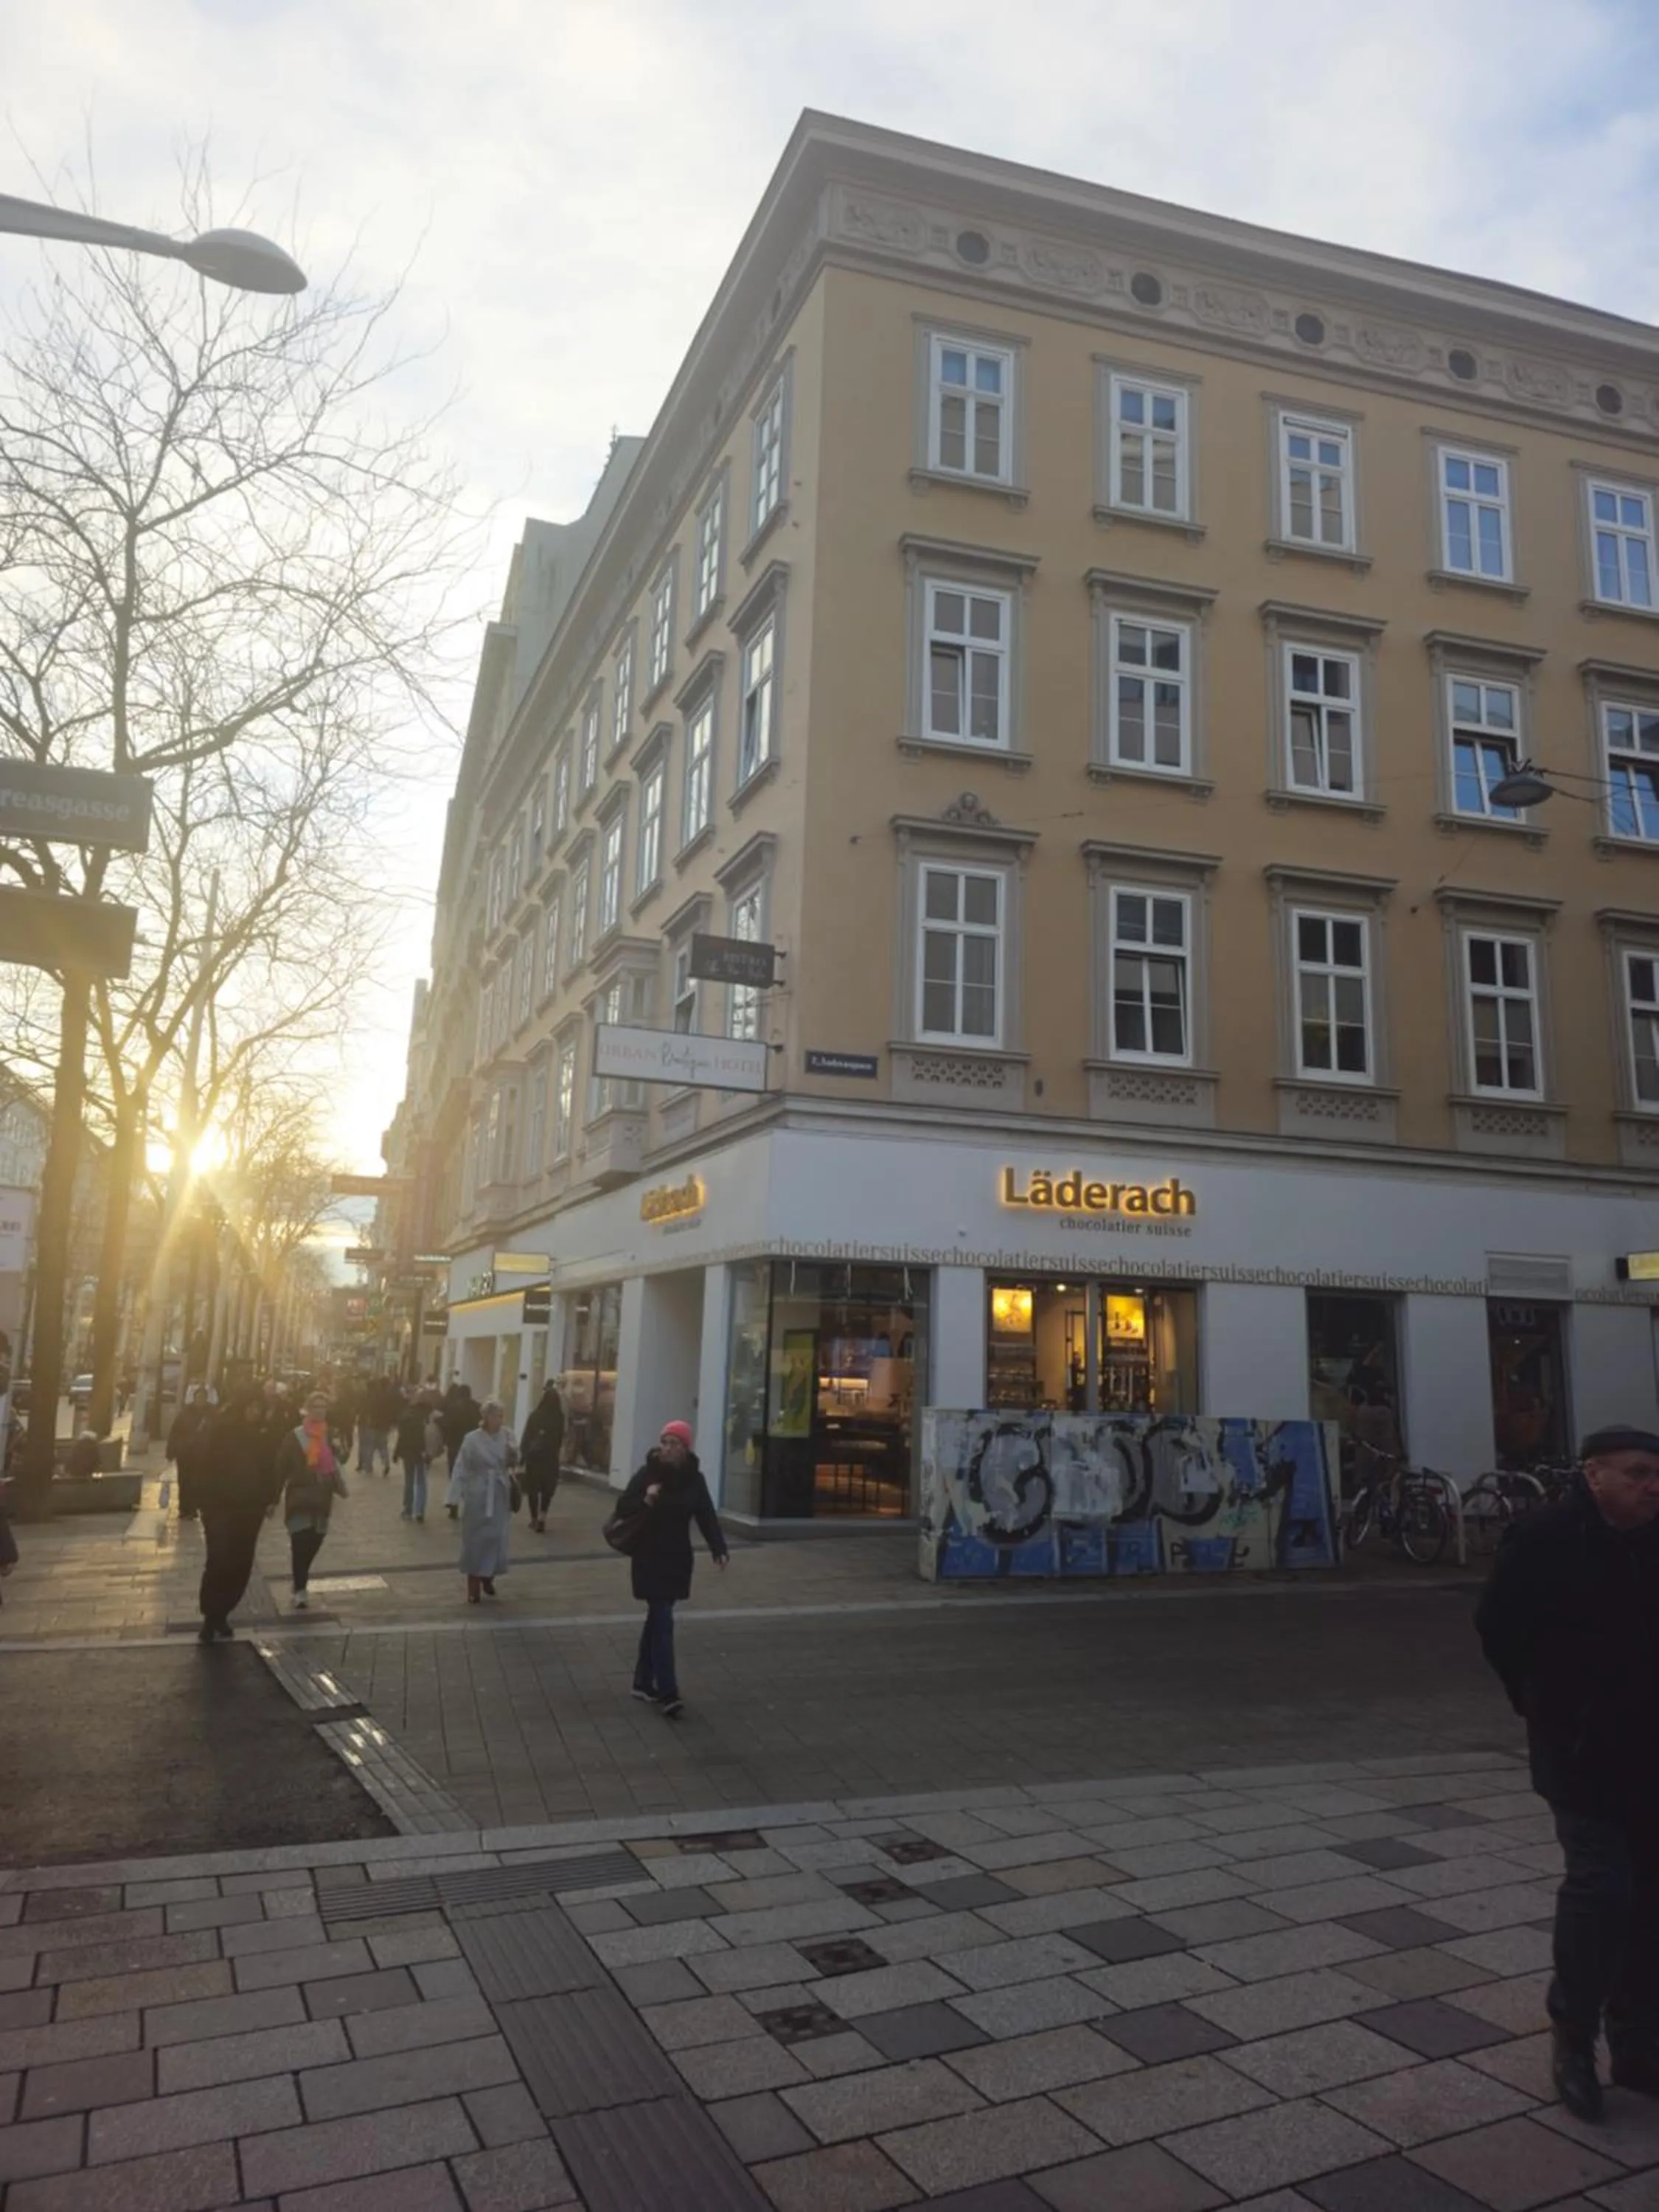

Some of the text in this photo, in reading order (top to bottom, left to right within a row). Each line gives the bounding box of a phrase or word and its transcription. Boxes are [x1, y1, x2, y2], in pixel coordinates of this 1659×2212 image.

[1005, 1166, 1196, 1216] Läderach
[1060, 1217, 1192, 1238] chocolatier suisse
